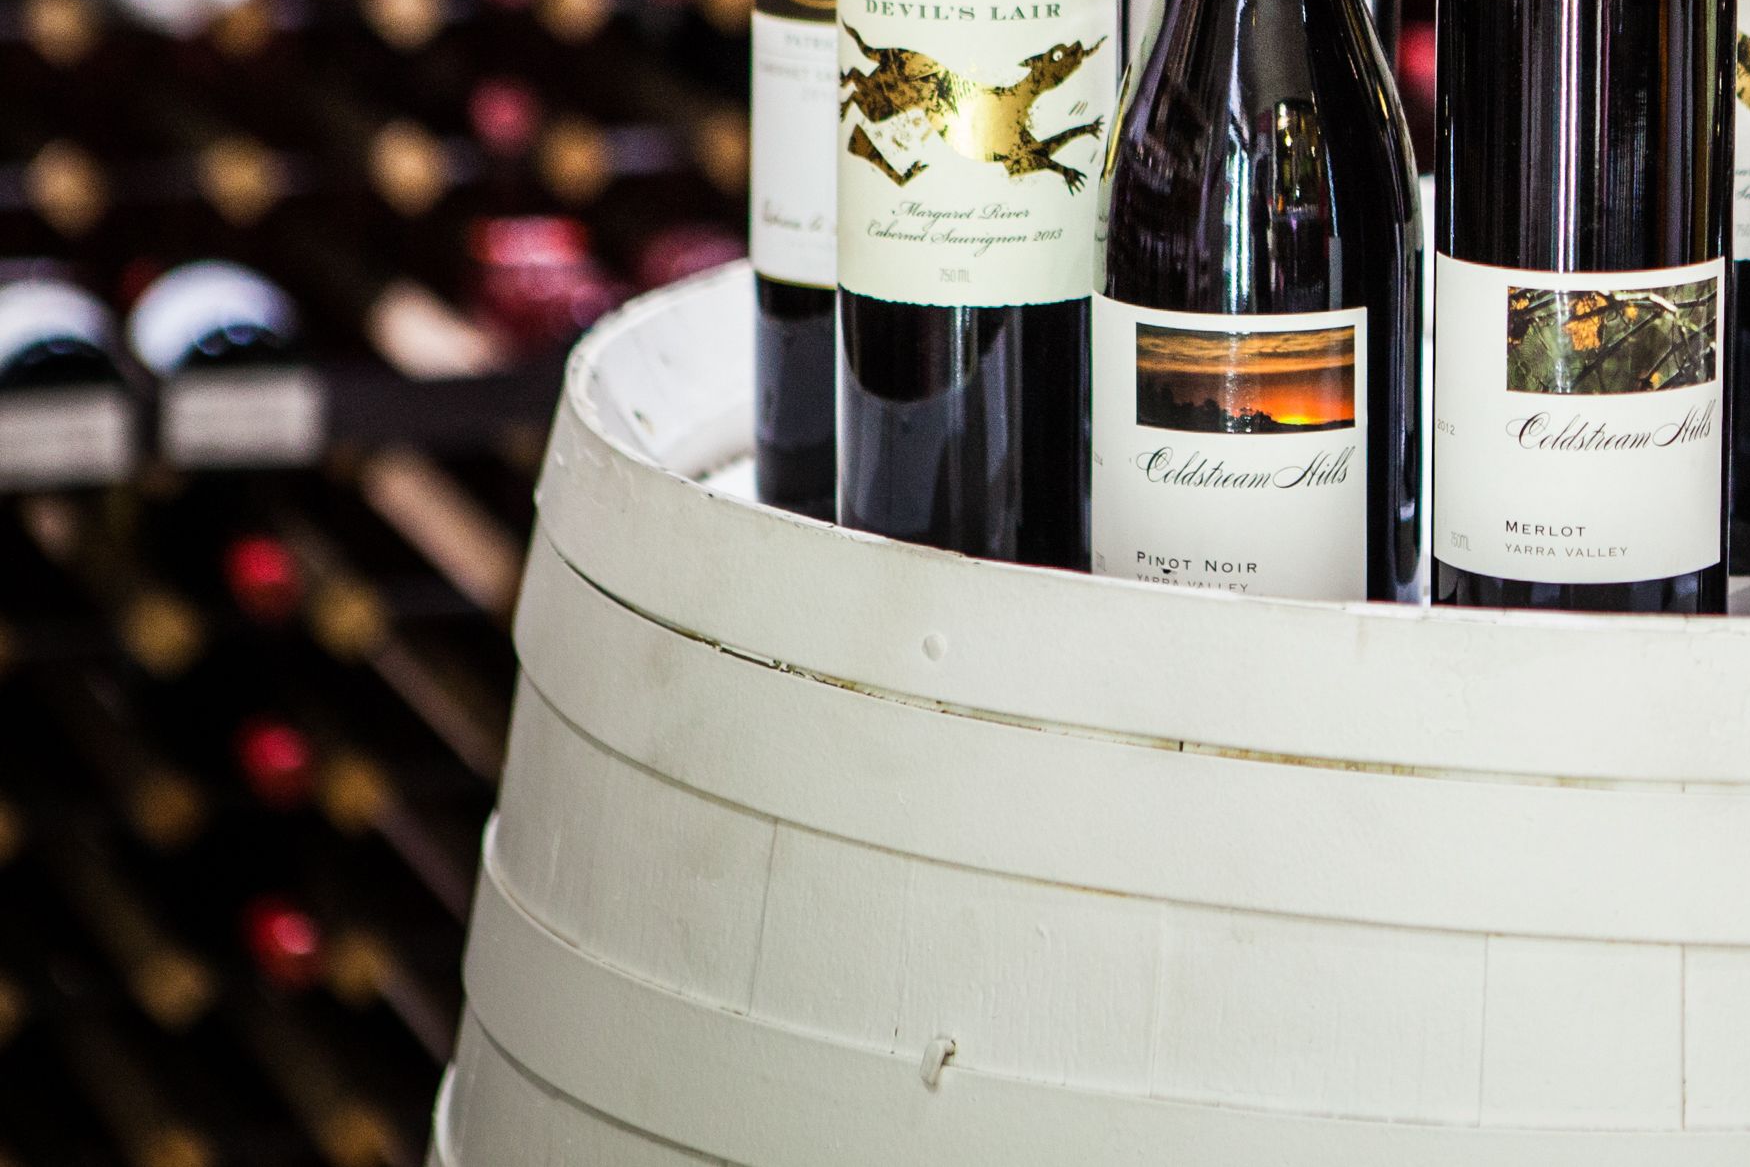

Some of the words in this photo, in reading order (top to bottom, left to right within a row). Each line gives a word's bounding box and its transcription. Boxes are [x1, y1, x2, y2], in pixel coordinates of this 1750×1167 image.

[989, 3, 1062, 21] LAIR
[892, 201, 974, 231] Margaret
[978, 203, 1030, 219] River
[867, 219, 927, 243] Cabernet
[931, 227, 1028, 257] Sauvignon
[1506, 411, 1652, 451] Coldstream
[1652, 399, 1717, 447] Hills
[1136, 446, 1272, 489] Coldstream
[1273, 445, 1356, 489] Hills
[1505, 520, 1586, 538] MERLOT
[1136, 550, 1192, 571] PINOT
[1205, 559, 1258, 574] NOIR
[1505, 543, 1556, 556] YARRA
[1565, 546, 1628, 558] VALLEY
